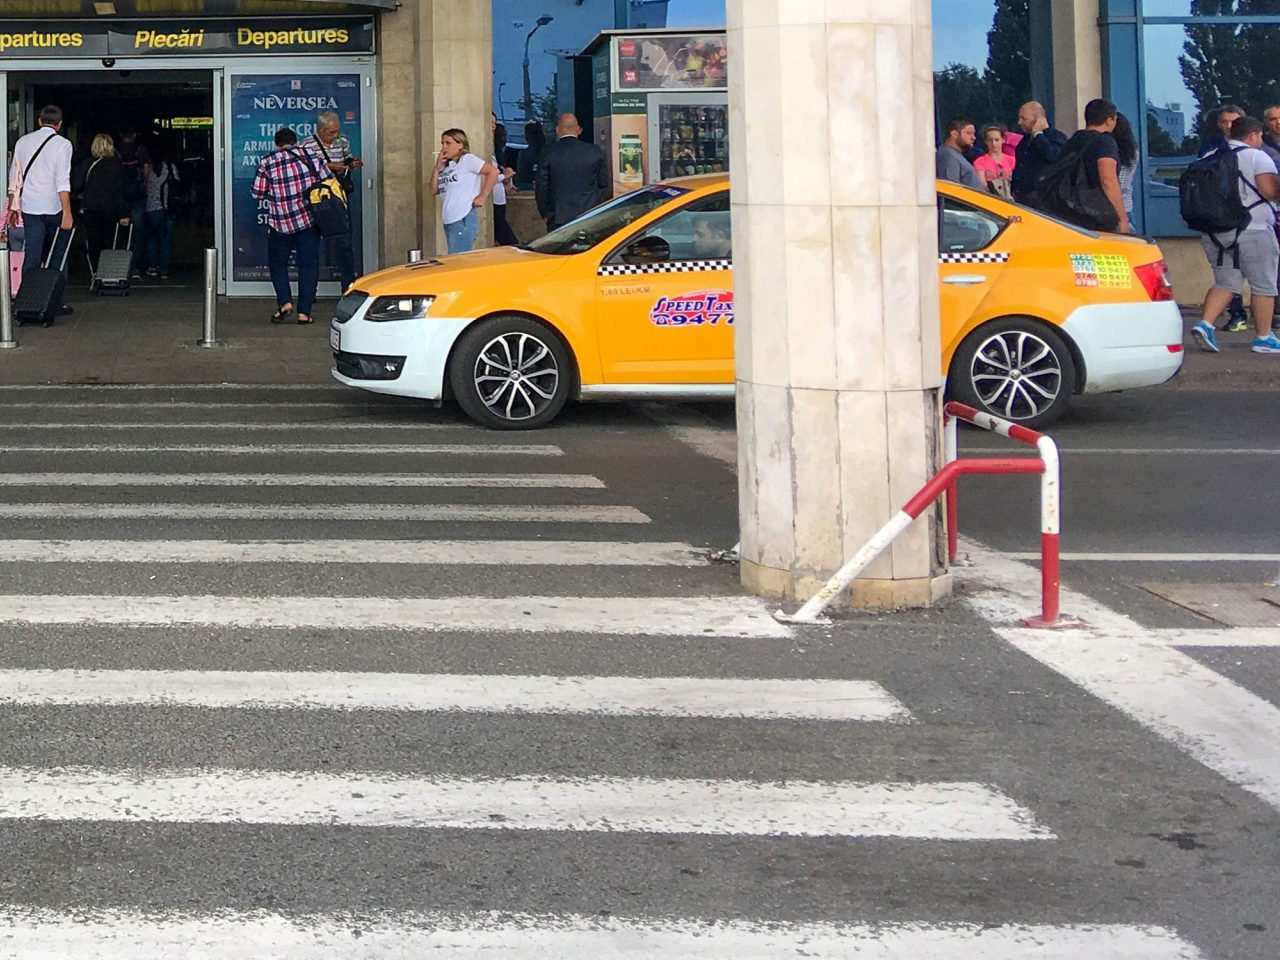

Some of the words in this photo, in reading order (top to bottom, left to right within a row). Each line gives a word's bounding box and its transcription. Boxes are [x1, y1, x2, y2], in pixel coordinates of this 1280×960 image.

[134, 28, 204, 49] Plecări
[237, 27, 349, 49] Departures
[253, 94, 338, 111] NEVERSEA
[705, 296, 734, 312] Tax
